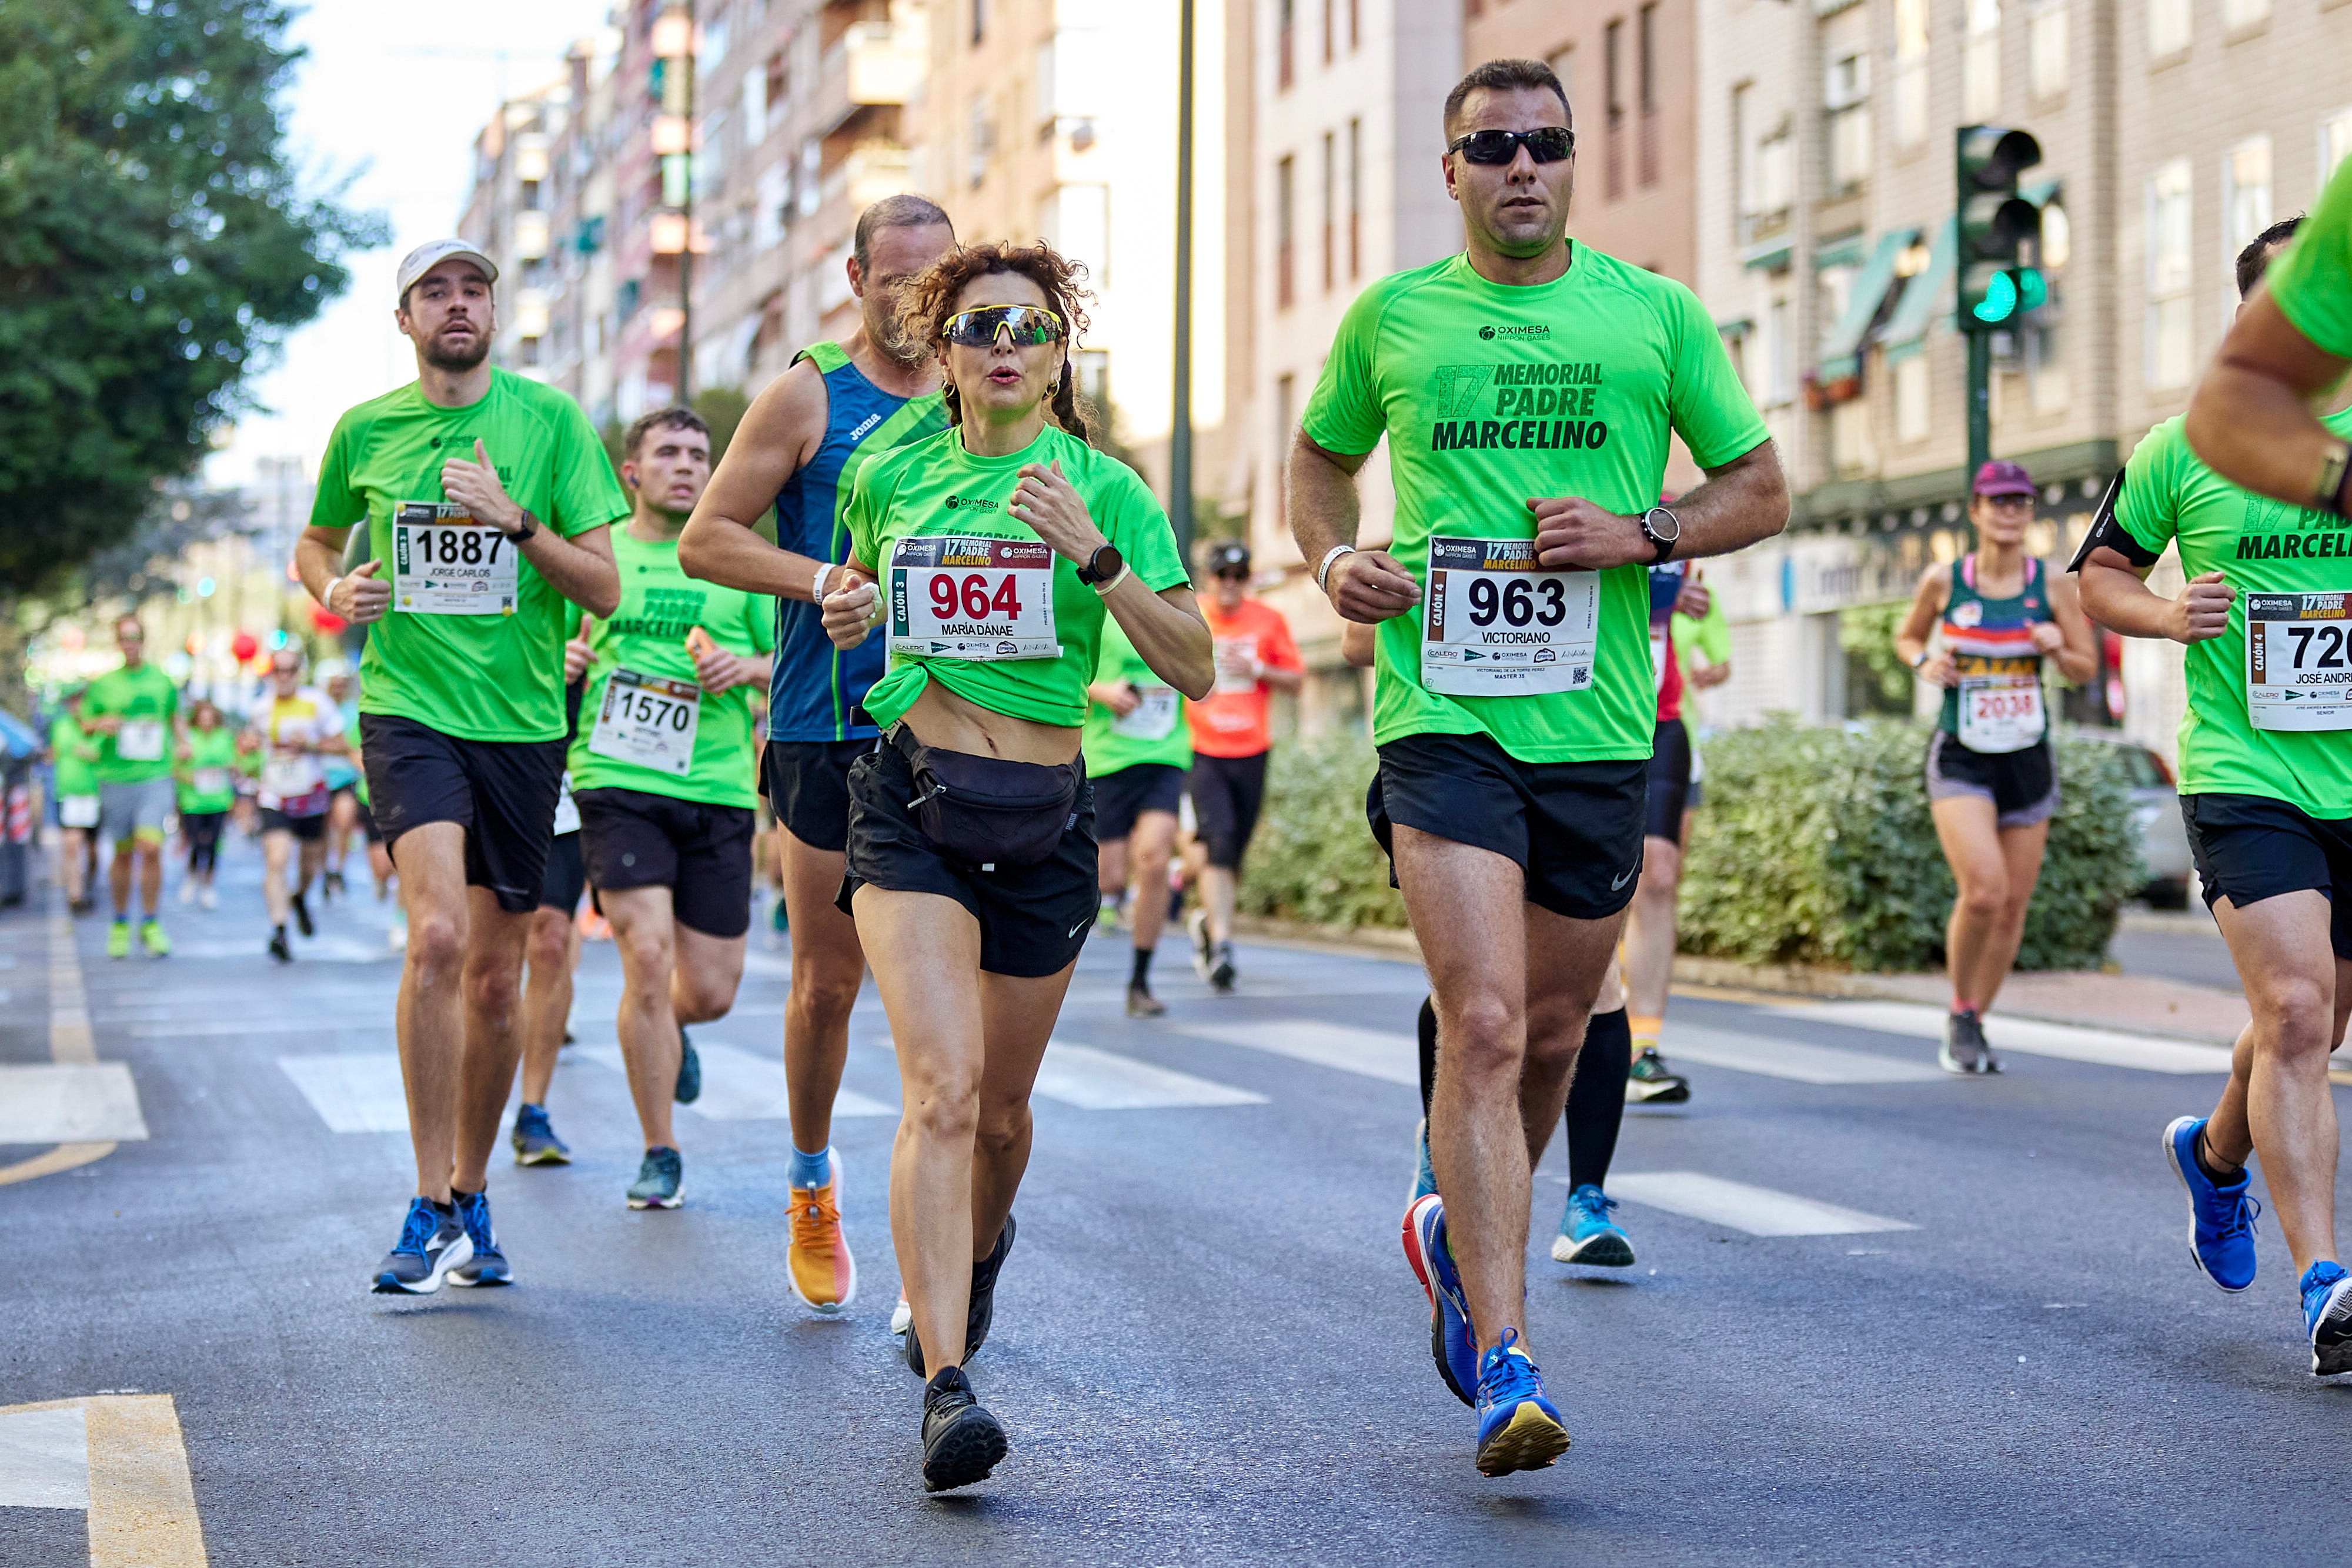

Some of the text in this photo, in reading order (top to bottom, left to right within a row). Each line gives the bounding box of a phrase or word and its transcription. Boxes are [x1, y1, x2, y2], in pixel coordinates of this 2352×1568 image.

[1498, 325, 1550, 334] OXIMESA
[1435, 363, 1603, 419] 17 MEMORIAL
[1495, 388, 1596, 416] PADRE
[1432, 420, 1607, 451] MARCELINO
[961, 498, 998, 509] OXIMESA
[416, 530, 504, 564] 1887
[944, 539, 992, 556] 17 MEMORIAL
[960, 546, 990, 556] PADRE
[1445, 544, 1476, 553] OXIMESA
[1486, 542, 1504, 560] 17
[1503, 550, 1533, 560] PADRE
[941, 555, 992, 566] MARCELINO
[1483, 559, 1536, 570] MARCELINO
[430, 568, 490, 577] JORGE CARLOS
[929, 573, 1022, 620] 964
[1469, 578, 1566, 627] 963
[2302, 595, 2317, 610] 17
[896, 593, 906, 622] CAJÓN
[1432, 593, 1444, 626] CAJÓN
[2317, 600, 2343, 610] PADRE
[2300, 609, 2346, 618] MARCELINO
[609, 620, 697, 637] MARCELIN
[941, 622, 1013, 636] MARÍA DÁNAE
[1482, 632, 1551, 644] VICTORIANO
[2254, 634, 2264, 671] CAJÓN 4
[2288, 626, 2352, 668] 72
[2296, 671, 2352, 684] JOSÉ ANDR
[622, 691, 690, 731] 1570
